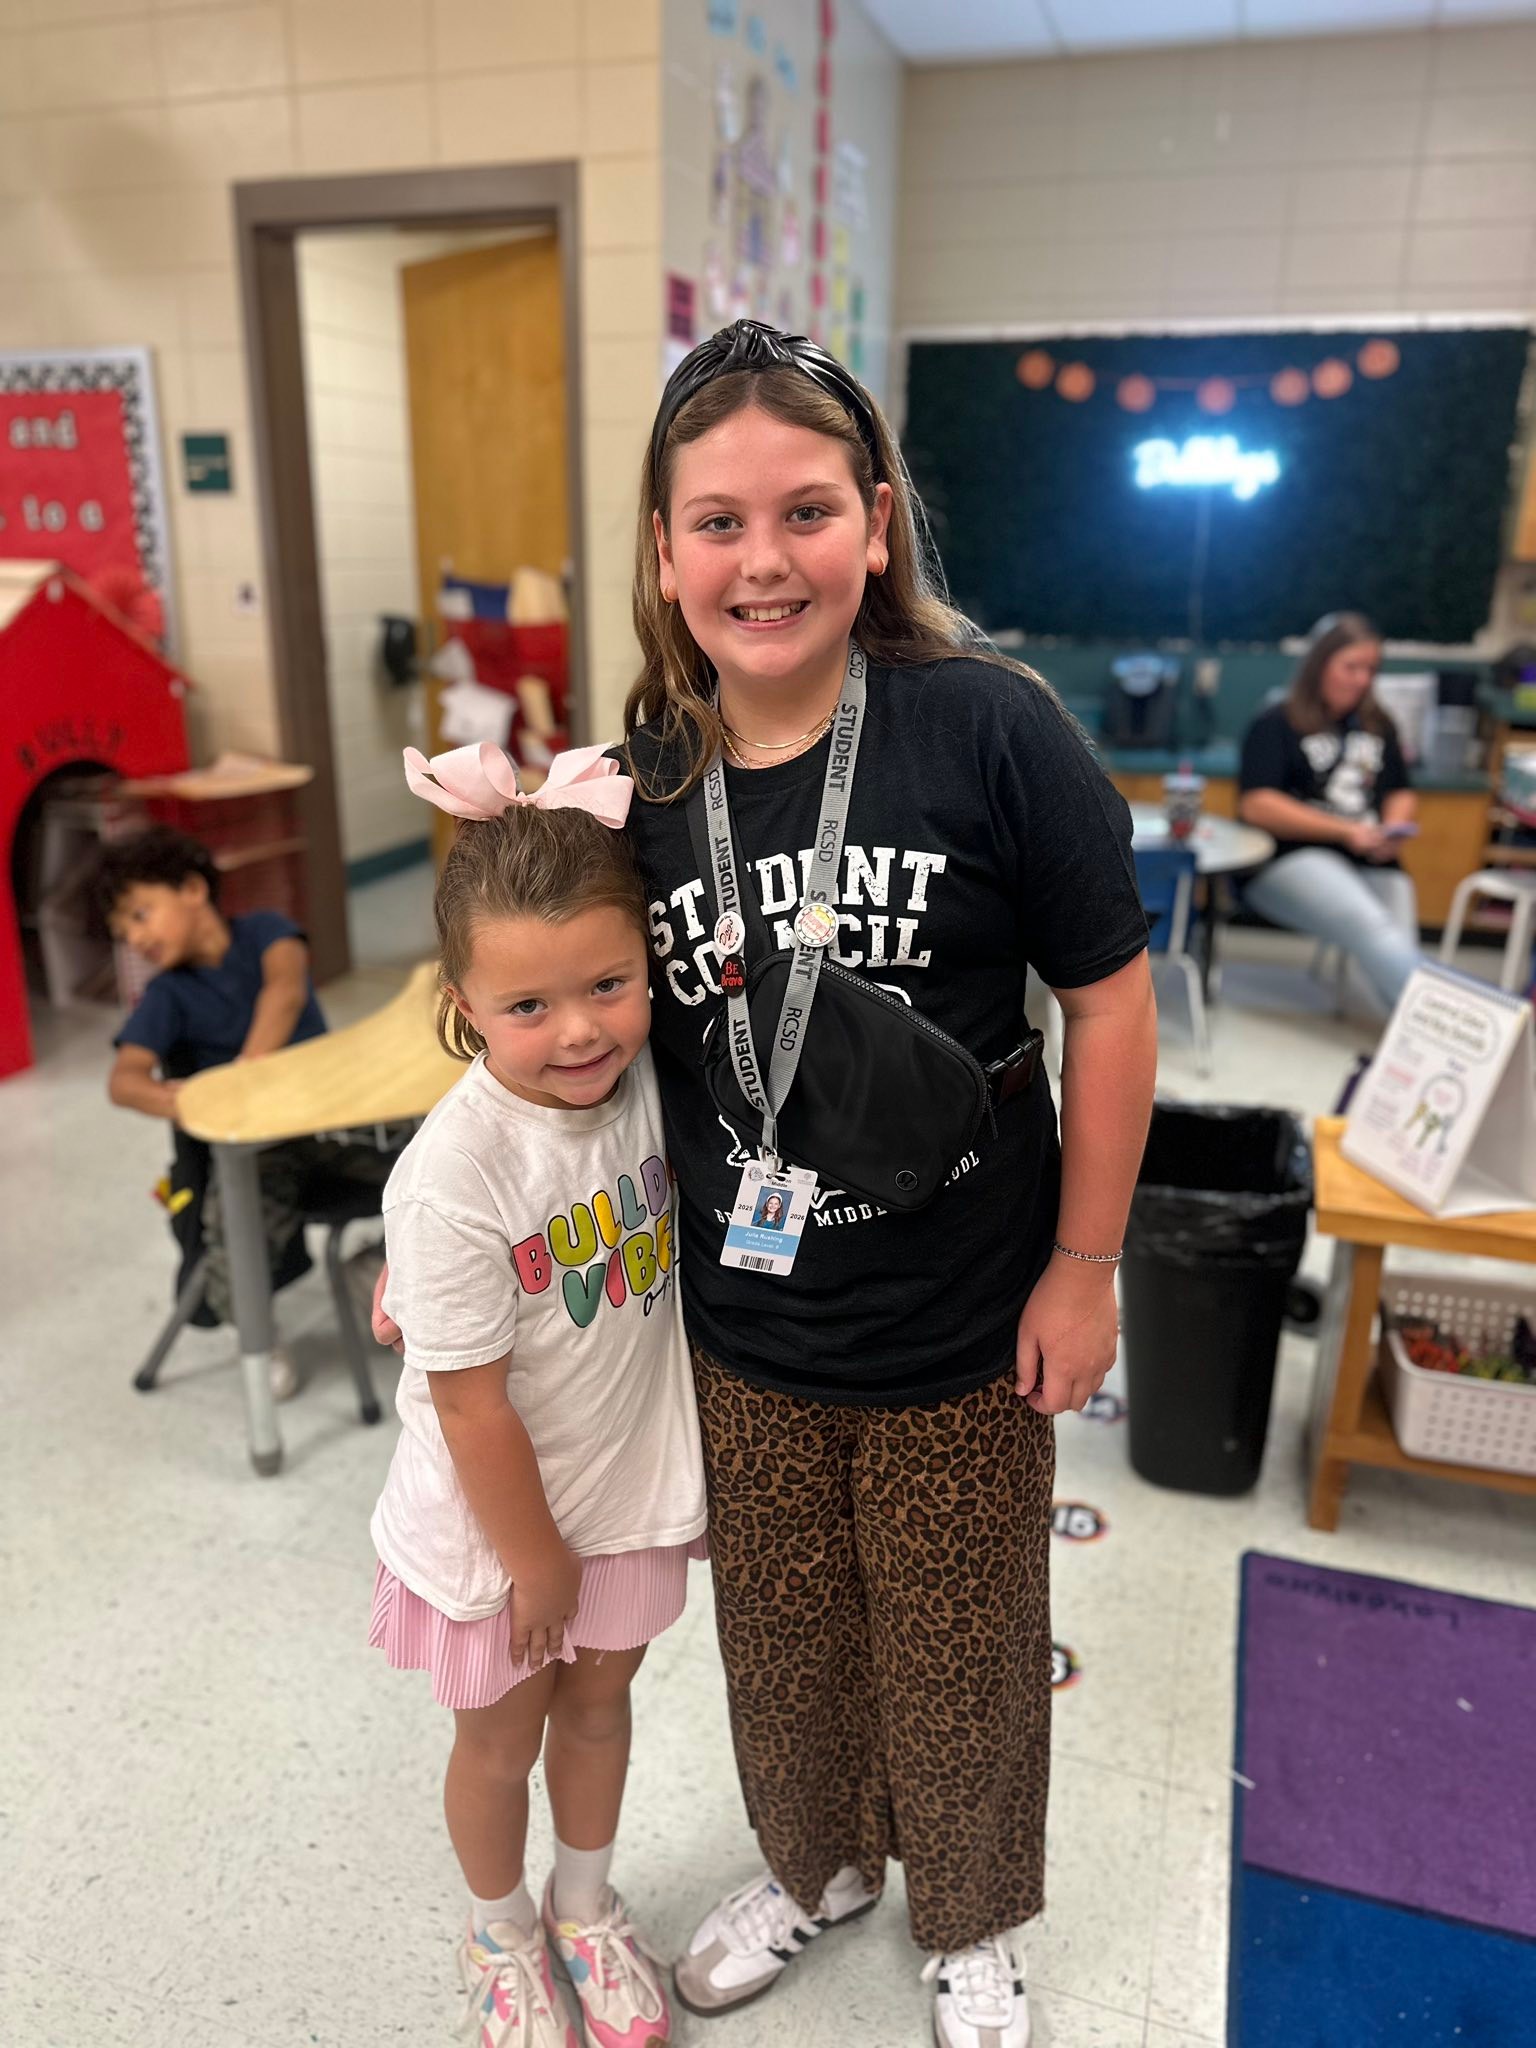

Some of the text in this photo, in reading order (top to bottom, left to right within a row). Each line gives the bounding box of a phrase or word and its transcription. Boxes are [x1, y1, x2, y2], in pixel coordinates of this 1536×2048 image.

[828, 703, 858, 793] STUDENT
[711, 768, 724, 811] RCSD
[818, 819, 839, 863] RCSD
[714, 837, 738, 913] TUDENT
[721, 974, 743, 987] Brave
[725, 961, 739, 975] BE
[780, 1006, 803, 1051] RCSD
[733, 1019, 765, 1108] STUDENT
[512, 1155, 677, 1294] BULLD
[738, 1204, 753, 1212] 2025
[789, 1213, 805, 1221] 2026
[813, 1203, 888, 1227] MIDDL
